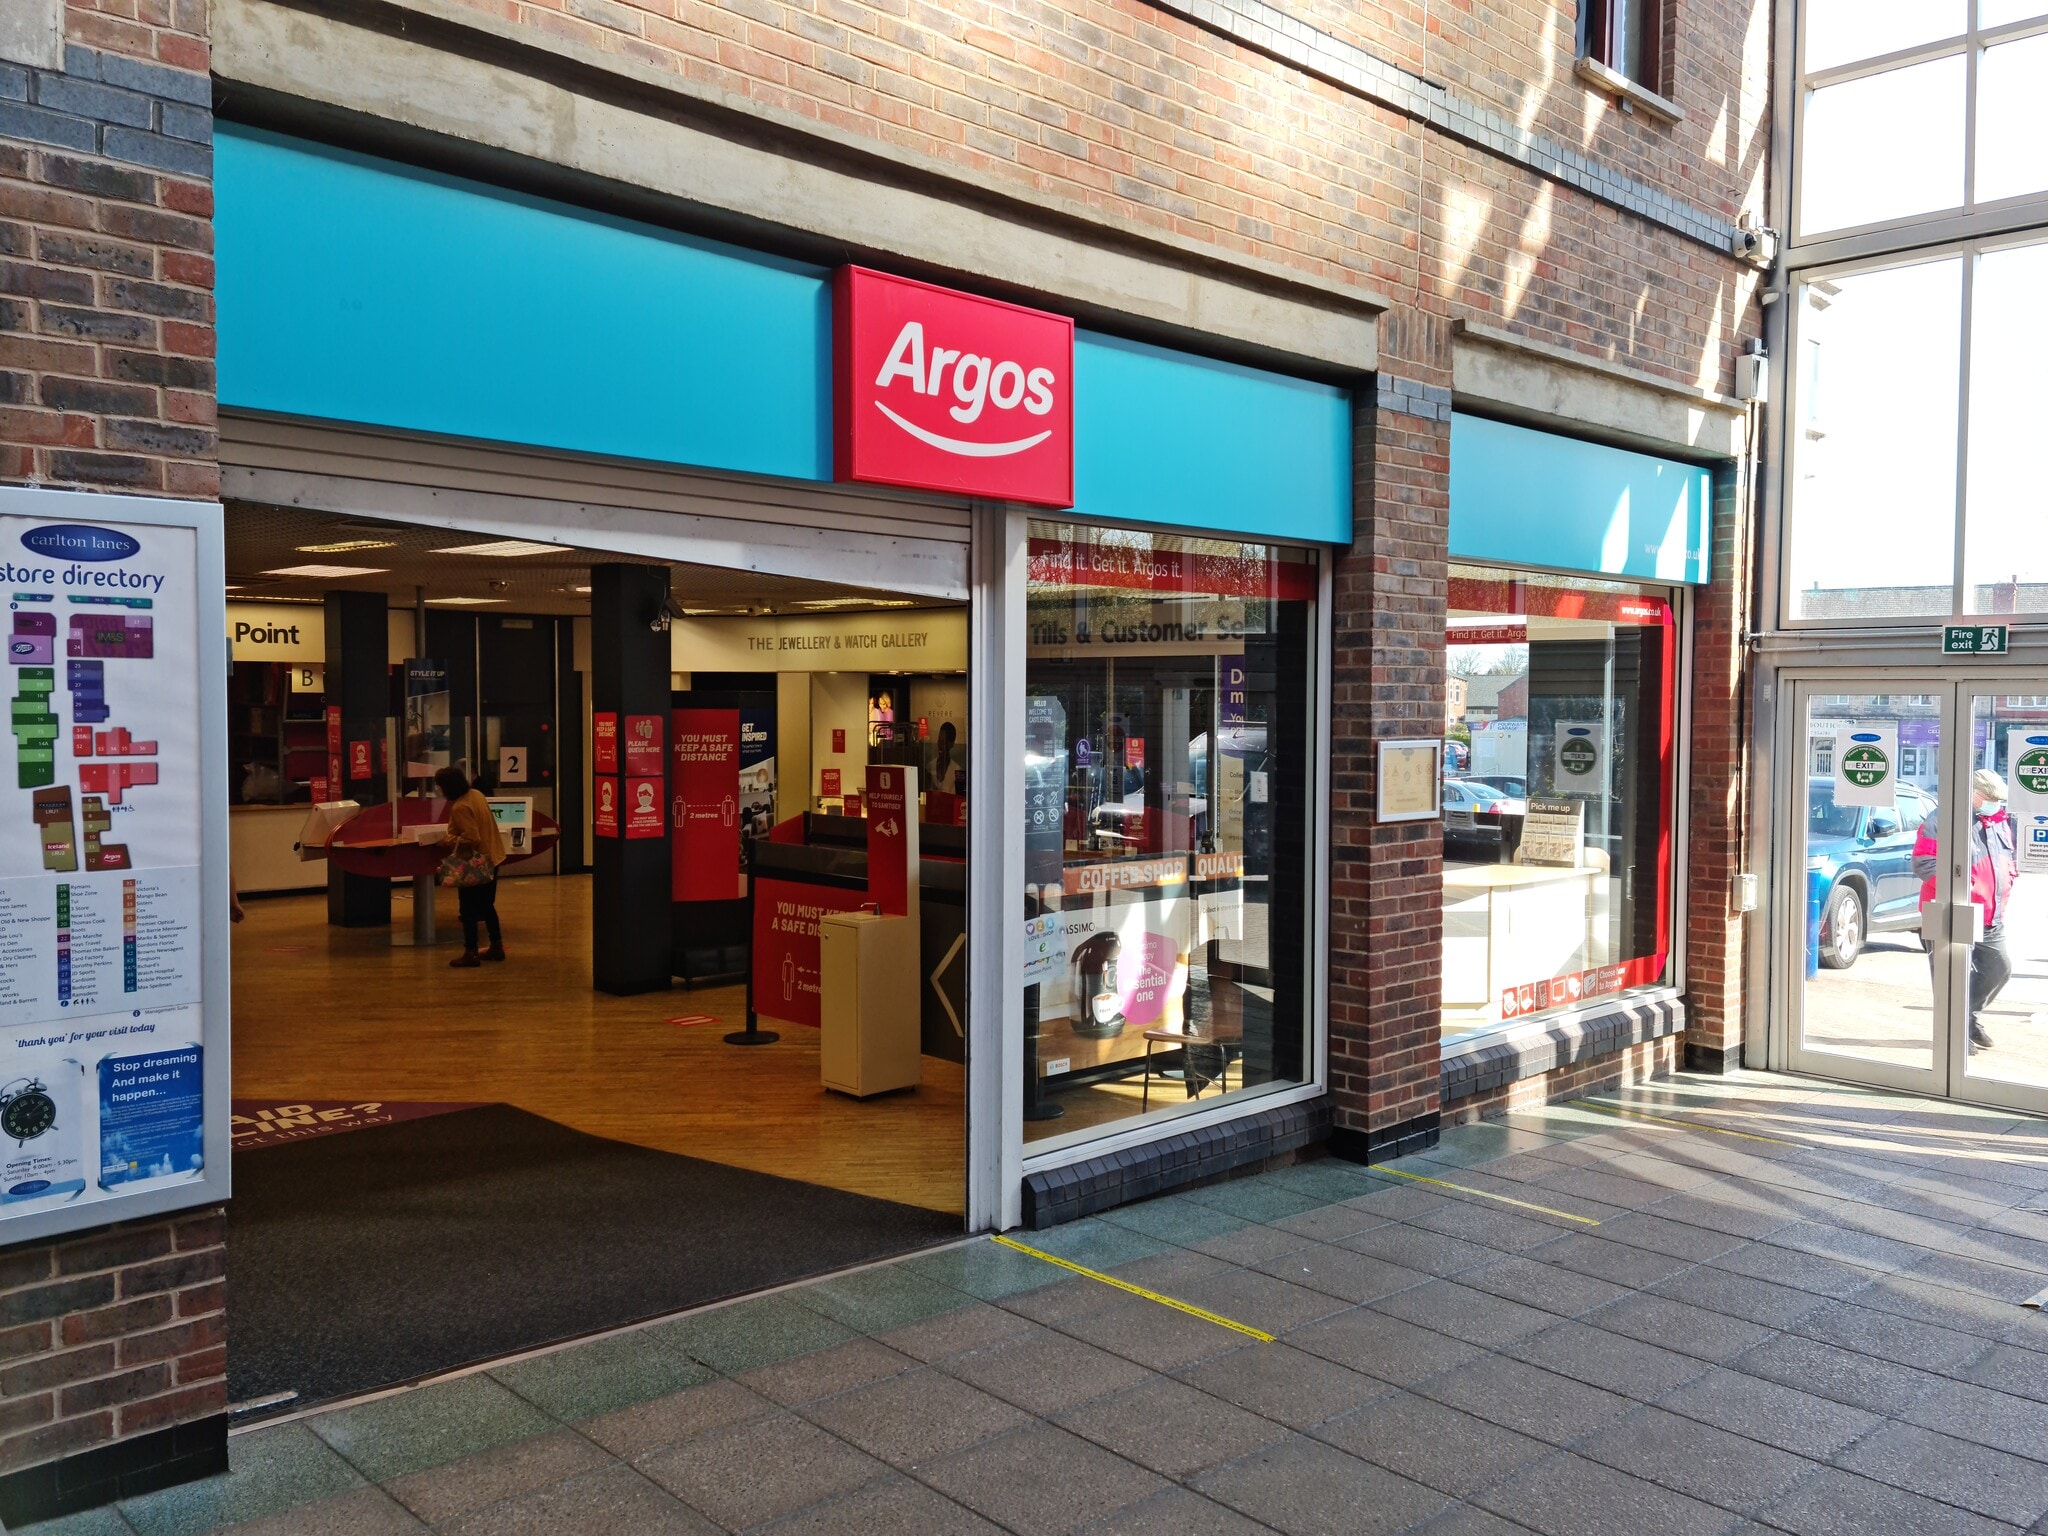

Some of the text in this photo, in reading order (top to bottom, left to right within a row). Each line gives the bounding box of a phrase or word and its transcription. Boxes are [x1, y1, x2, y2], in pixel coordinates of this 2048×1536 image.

[875, 321, 1055, 424] Argos
[31, 533, 130, 551] carlton lanes
[1042, 550, 1183, 581] Find it. Get it. Argos it.
[0, 562, 165, 593] store directory
[235, 621, 300, 645] Point
[1031, 615, 1244, 645] Tills & Customer Se
[1451, 630, 1469, 639] Find
[1471, 629, 1479, 639] it.
[1480, 630, 1495, 639] Get
[1497, 629, 1505, 638] it.
[1951, 629, 1974, 639] Fire
[747, 632, 928, 650] THE JEWELLERY & WATCH GALLERY
[1951, 640, 1973, 649] exit
[301, 669, 314, 687] B
[1230, 668, 1245, 686] D
[928, 710, 953, 718] REVERE
[1028, 708, 1047, 716] WELCOME
[741, 723, 754, 733] GET
[680, 734, 728, 743] YOU MUST
[741, 731, 768, 742] INSPIRED
[674, 743, 699, 752] KEEP
[699, 743, 708, 752] A
[708, 743, 734, 752] SAFE
[680, 753, 728, 761] DISTANCE
[507, 755, 519, 773] 2
[868, 792, 881, 800] HELP
[877, 802, 902, 810] SANITISER
[1530, 802, 1547, 810] Pick
[1560, 805, 1571, 813] up
[2036, 830, 2047, 841] P
[104, 853, 121, 861] Argos
[1080, 860, 1184, 889] COFFEE SHOP
[776, 901, 824, 920] YOU MUST
[771, 917, 779, 930] A
[780, 918, 806, 935] SAFE
[2, 946, 33, 954] Accessories
[14, 953, 37, 961] Cleaners
[1600, 969, 1616, 979] Choose
[797, 980, 803, 990] 2
[1600, 982, 1605, 990] to
[1136, 989, 1155, 1003] one
[69, 1032, 84, 1044] for
[85, 1030, 107, 1042] your
[109, 1026, 128, 1036] visit
[130, 1023, 156, 1034] today
[113, 1054, 197, 1073] Stop dreaming
[112, 1070, 181, 1088] And make it
[112, 1088, 167, 1103] happen...
[275, 1125, 334, 1139] this
[340, 1114, 393, 1128] way
[6, 1159, 32, 1169] Opening
[4, 1168, 56, 1183] Sunday 10am 4pm
[7, 1166, 31, 1176] Saturday
